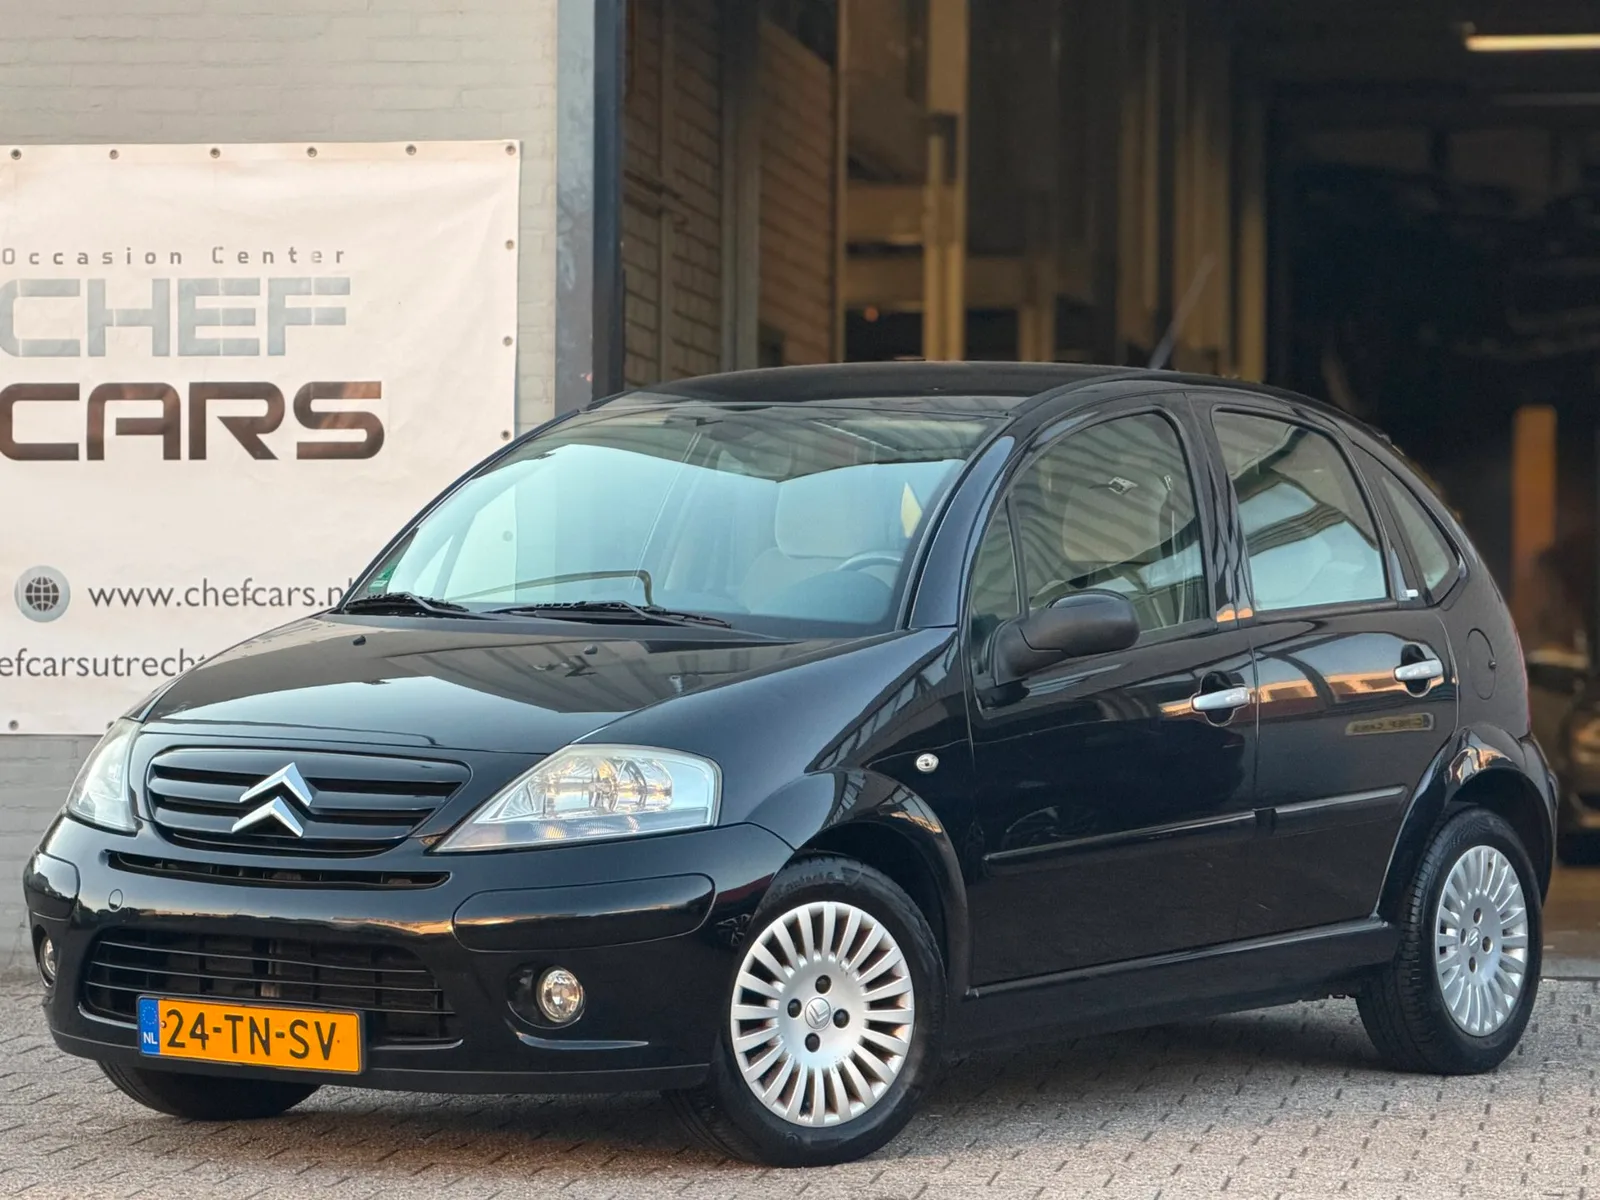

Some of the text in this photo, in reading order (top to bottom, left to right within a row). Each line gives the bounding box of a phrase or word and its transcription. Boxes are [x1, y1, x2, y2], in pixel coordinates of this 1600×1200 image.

[1, 246, 345, 265] Occasion Center
[0, 276, 351, 358] CHEF
[0, 380, 385, 462] CARS
[0, 647, 207, 677] efcarsutrech
[143, 1031, 158, 1045] NL
[165, 1008, 337, 1061] 24-TN-SV
